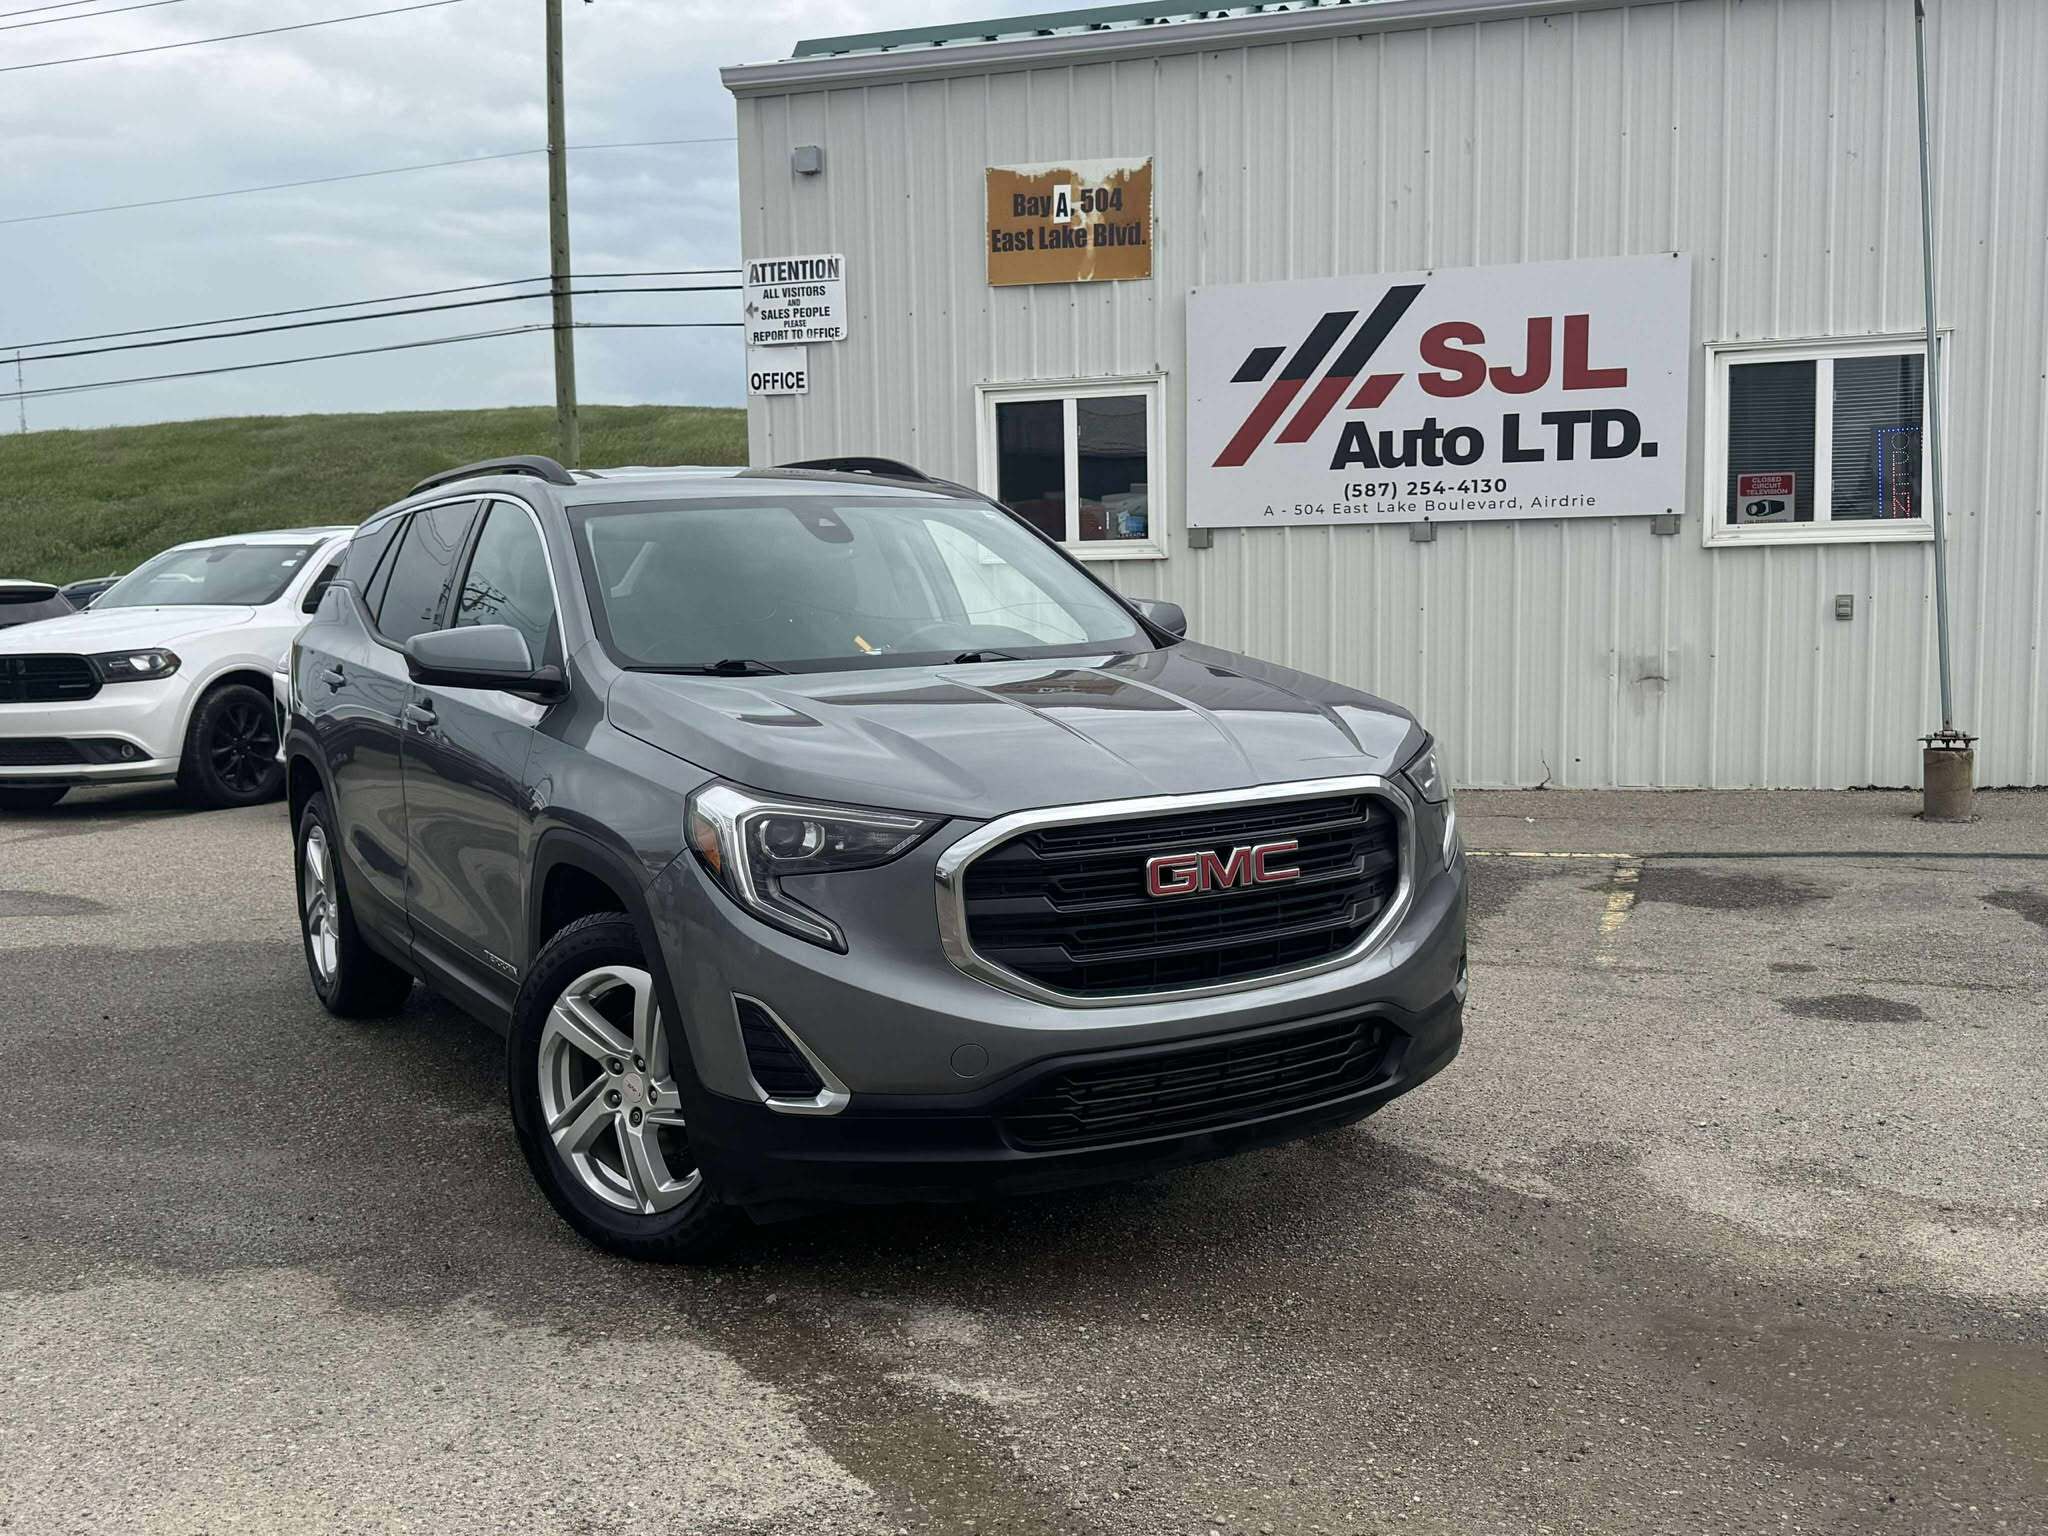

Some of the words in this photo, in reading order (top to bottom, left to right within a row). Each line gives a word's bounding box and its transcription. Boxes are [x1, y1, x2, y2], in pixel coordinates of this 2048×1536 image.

[1013, 193, 1052, 218] Bay
[1080, 187, 1123, 213] 504
[991, 227, 1034, 252] East
[1039, 224, 1088, 250] Lake
[1093, 222, 1147, 247] Blvd.
[749, 258, 840, 283] ATTENTION
[763, 288, 779, 299] ALL
[782, 286, 826, 298] VISITORS
[787, 299, 800, 307] AND
[761, 308, 790, 320] SALES
[793, 306, 830, 318] PEOPLE
[784, 319, 807, 328] PLEASE
[753, 329, 788, 342] REPORT
[792, 328, 803, 339] TO
[807, 326, 840, 339] OFFICE
[1417, 313, 1629, 398] SJL
[751, 371, 806, 391] OFFICE
[1329, 417, 1484, 471] Auto
[1501, 408, 1659, 464] LTD.
[1344, 481, 1398, 501] (587)
[1407, 478, 1508, 496] 254-4130
[1264, 504, 1275, 517] A
[1294, 503, 1325, 516] 504
[1333, 502, 1369, 515] East
[1377, 499, 1417, 514] Lake
[1425, 496, 1523, 513] Boulevard,
[1531, 494, 1597, 509] Airdrie
[1146, 840, 1300, 897] GMC
